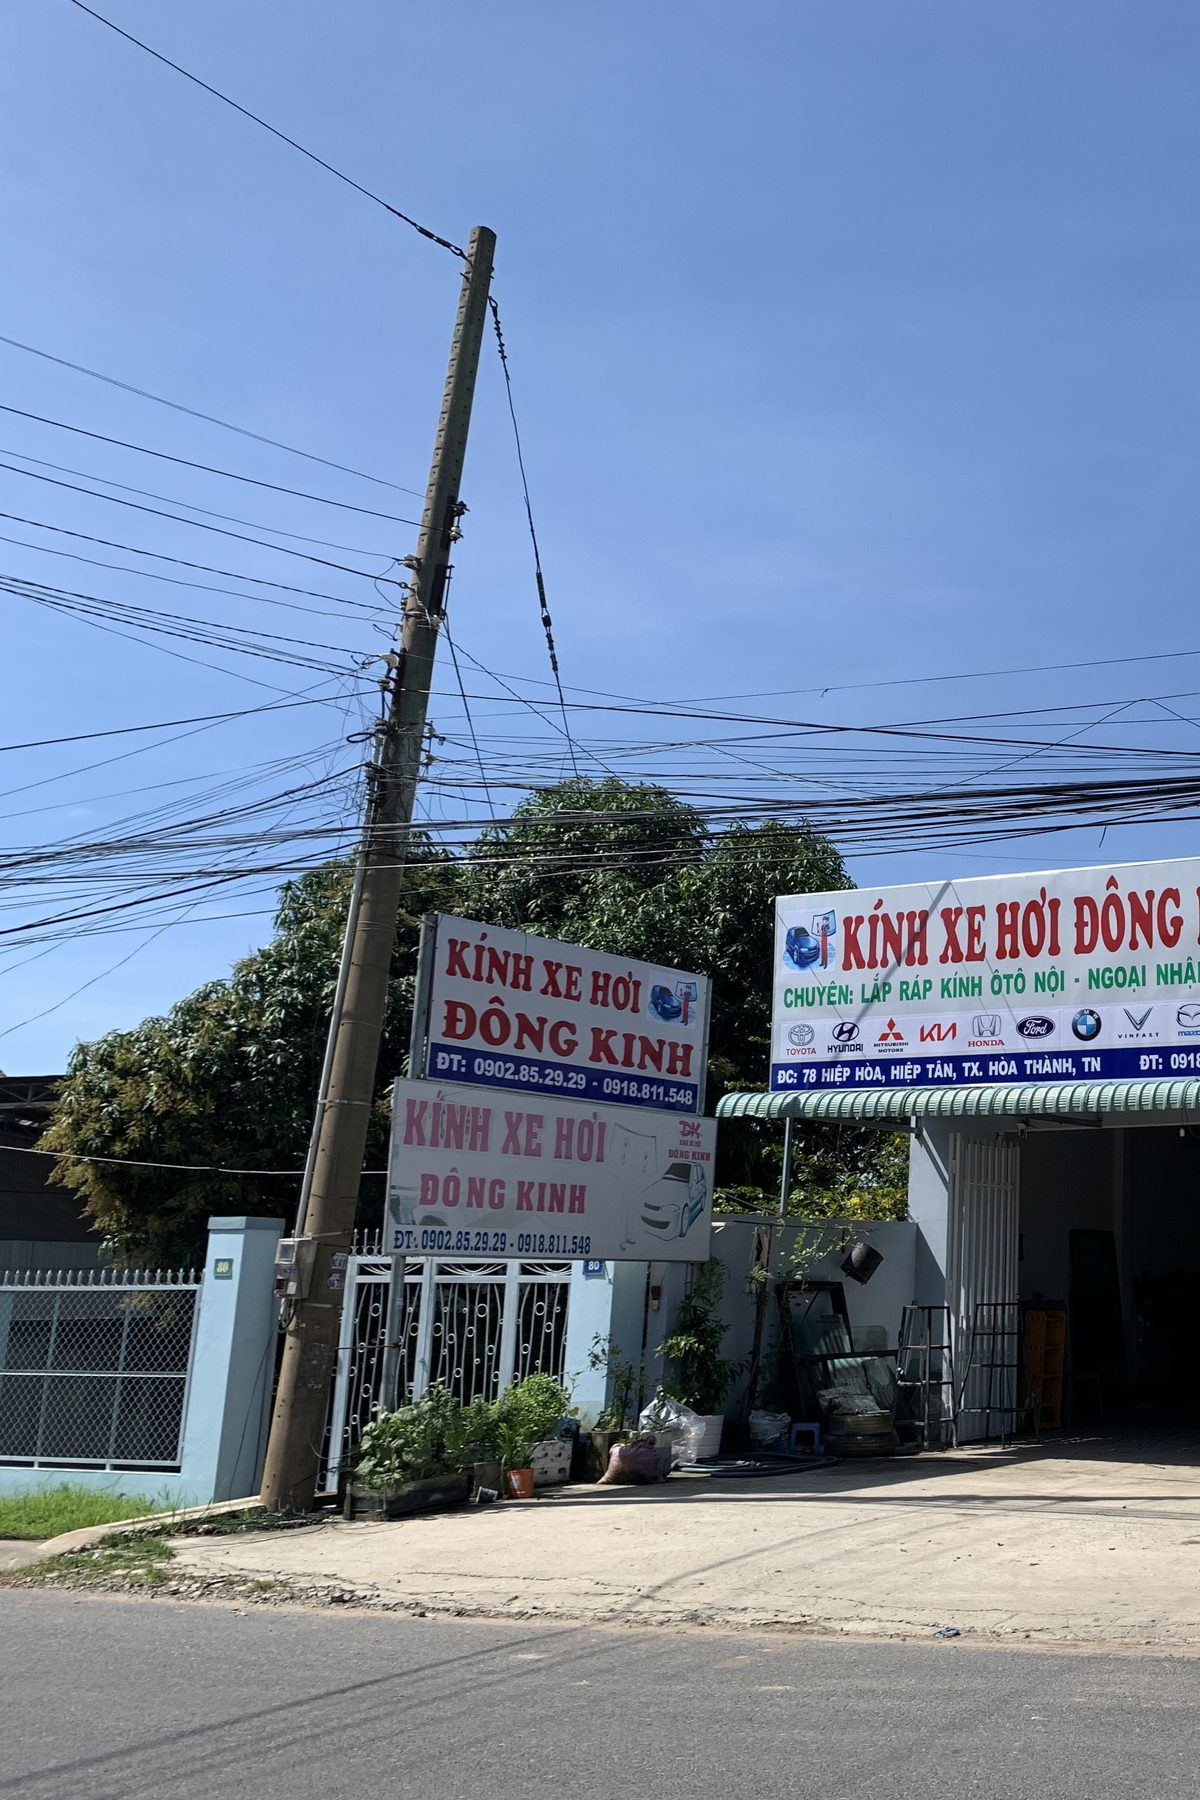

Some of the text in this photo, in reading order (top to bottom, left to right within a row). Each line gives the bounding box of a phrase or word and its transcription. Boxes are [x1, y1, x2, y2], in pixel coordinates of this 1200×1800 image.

[842, 898, 929, 971] KÍNH
[939, 904, 987, 964] XE
[995, 886, 1061, 960] HƠI
[1073, 874, 1184, 955] ĐÔNG
[446, 932, 642, 1013] KÍNH XE HƠI
[783, 980, 853, 1008] CHUYÊN:
[861, 973, 892, 1004] LẮP
[899, 974, 933, 1001] RÁP
[940, 971, 983, 999] KÍNH
[990, 967, 1026, 995] ÔTÔ
[1034, 966, 1065, 998] NỘI
[1088, 965, 1146, 992] NGOẠI
[441, 996, 694, 1077] ĐÔNG KINH
[1023, 1019, 1048, 1035] Ford
[786, 1047, 817, 1055] TOYOTA
[827, 1044, 863, 1053] HYUNDAI
[967, 1039, 1005, 1048] HONDA
[777, 1055, 1101, 1086] ĐC: 78 HIỆP HÒA, HIỆP TÂN, TX. HÒA THÀNH, TN
[1139, 1055, 1163, 1071] ĐT:
[435, 1051, 467, 1073] ĐT:
[474, 1057, 586, 1090] 0902.85.29.29
[603, 1077, 693, 1105] 0918.811.548
[403, 1090, 607, 1163] KÍNH XE HƠI
[418, 1167, 587, 1214] ĐÔNG KINH
[394, 1230, 419, 1250] ĐT:
[421, 1230, 506, 1251] 0902.85.29.29
[517, 1232, 591, 1255] 0918.811.548
[216, 1261, 229, 1273] 80
[588, 1261, 600, 1270] 80
